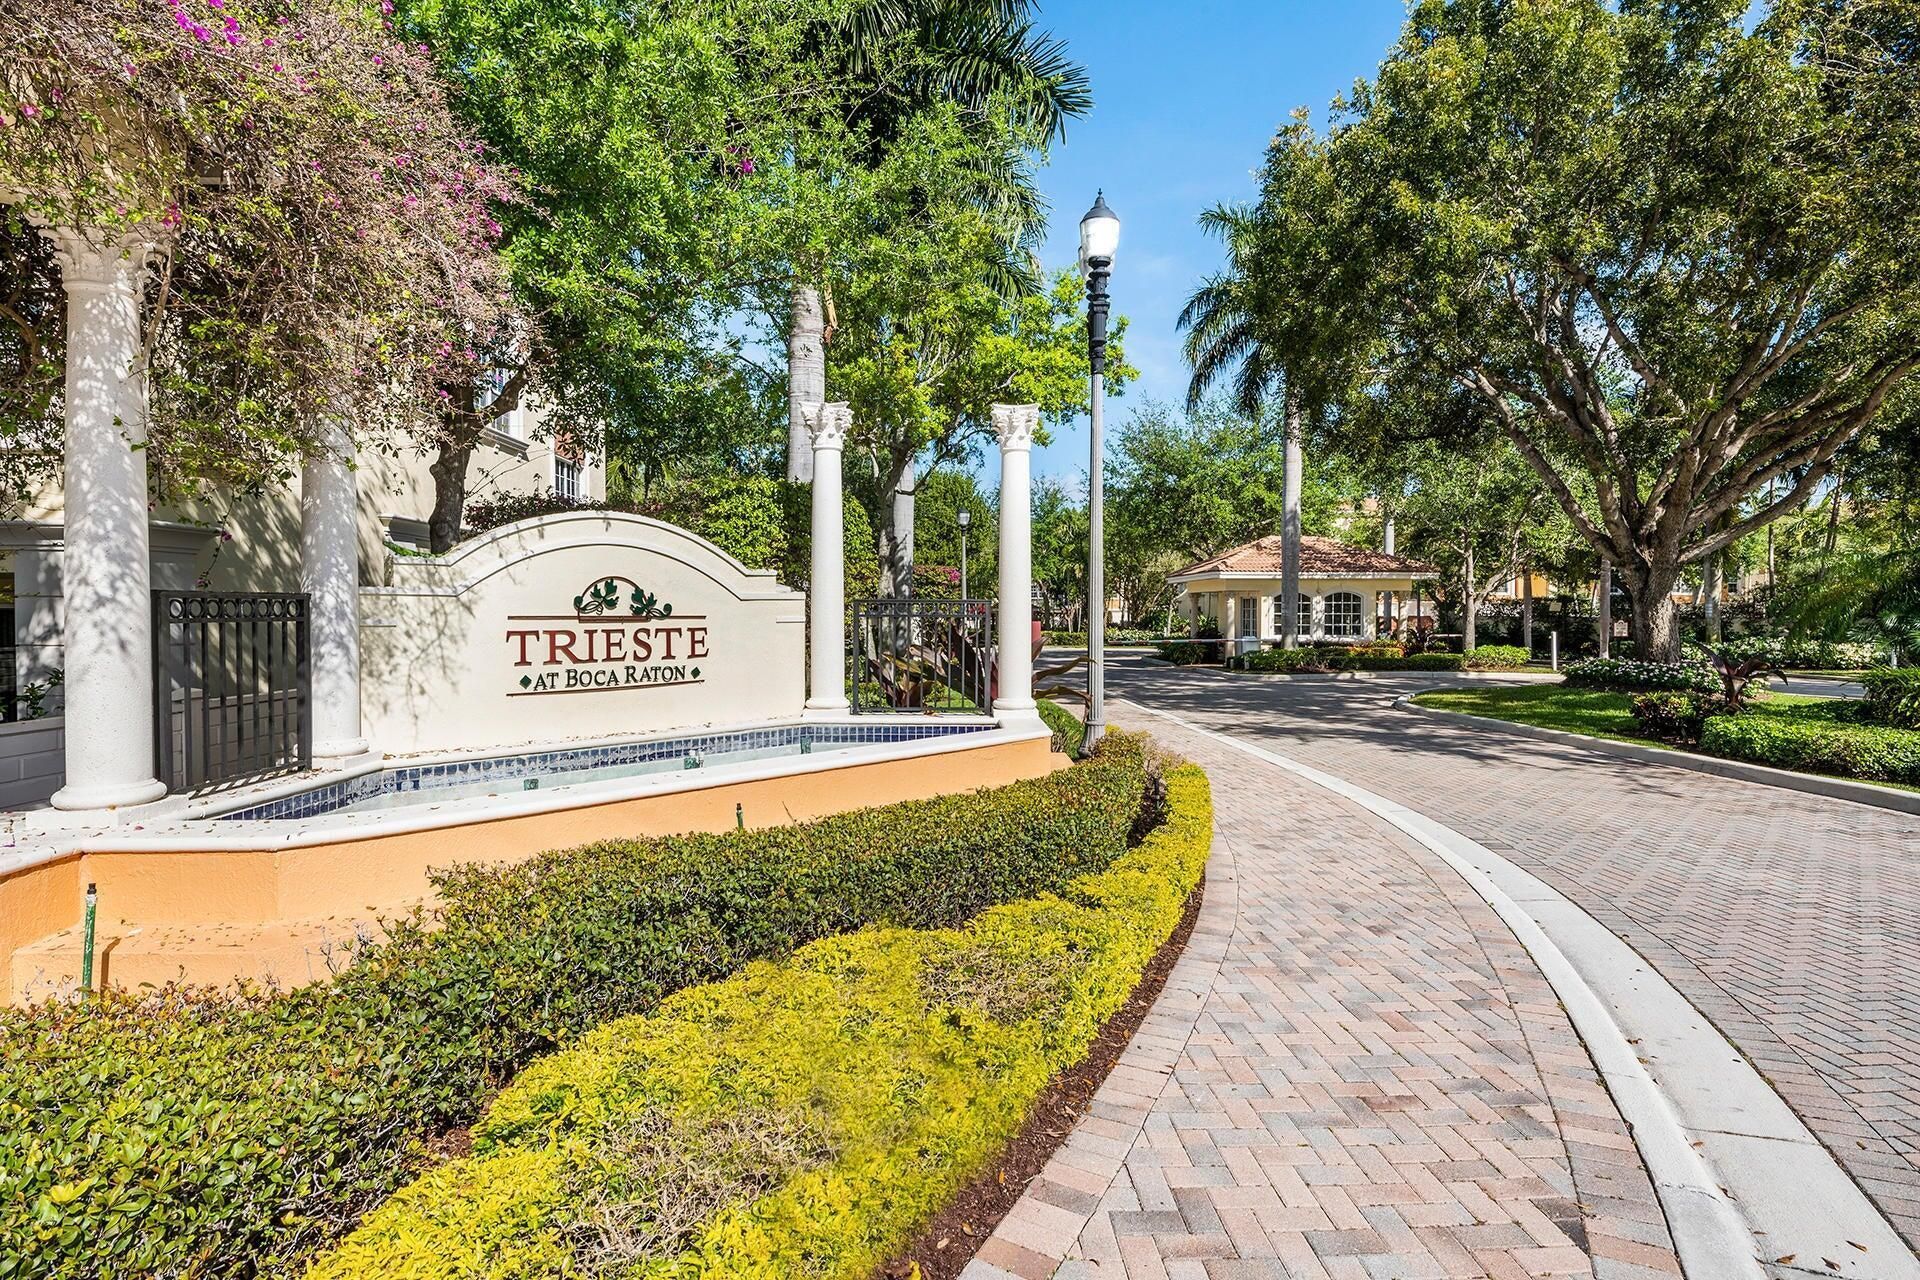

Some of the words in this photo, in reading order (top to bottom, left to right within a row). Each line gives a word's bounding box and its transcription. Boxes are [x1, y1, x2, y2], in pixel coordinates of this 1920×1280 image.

[506, 627, 709, 667] TRIESTE
[533, 672, 559, 691] AT
[565, 668, 620, 689] BOCA
[624, 665, 686, 684] RATON
